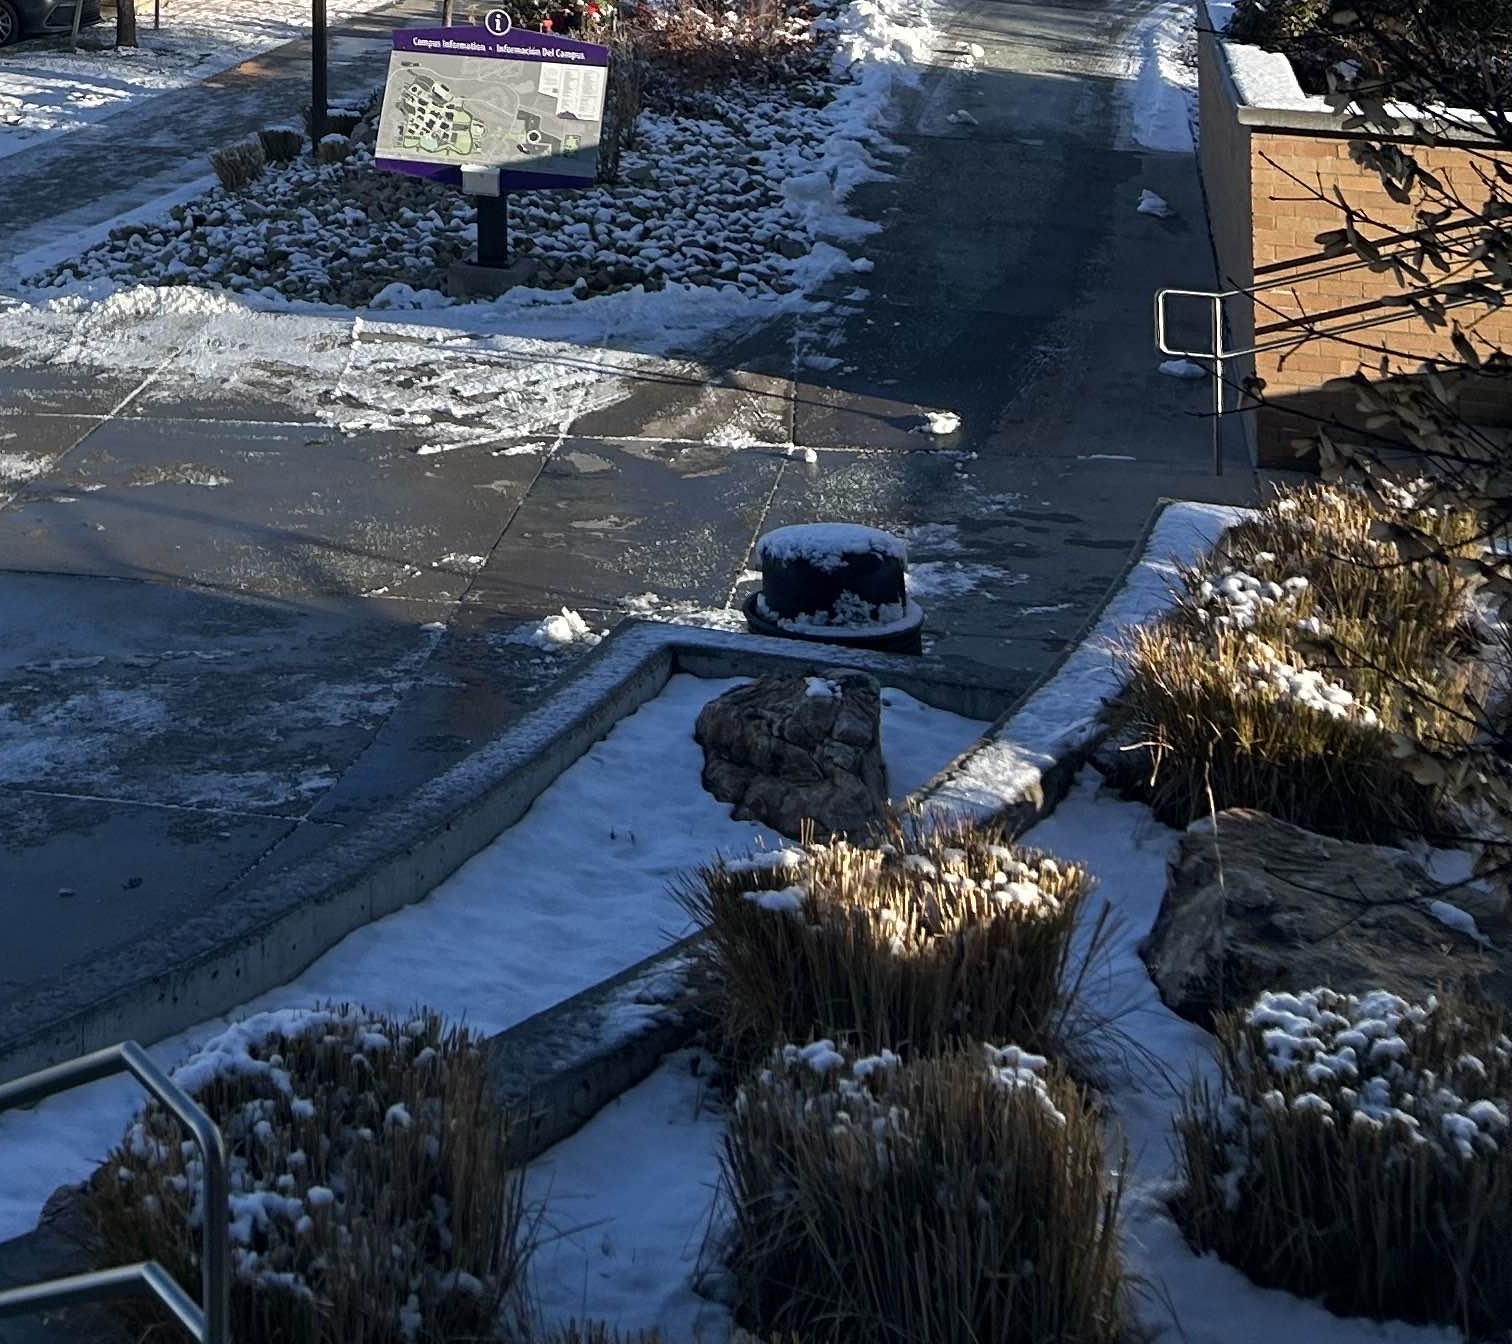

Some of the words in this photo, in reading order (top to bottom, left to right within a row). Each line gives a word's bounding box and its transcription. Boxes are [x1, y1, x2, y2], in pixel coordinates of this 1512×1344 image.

[412, 37, 441, 48] Campus
[442, 39, 486, 51] Information
[542, 47, 555, 57] Del
[555, 49, 586, 60] Campus
